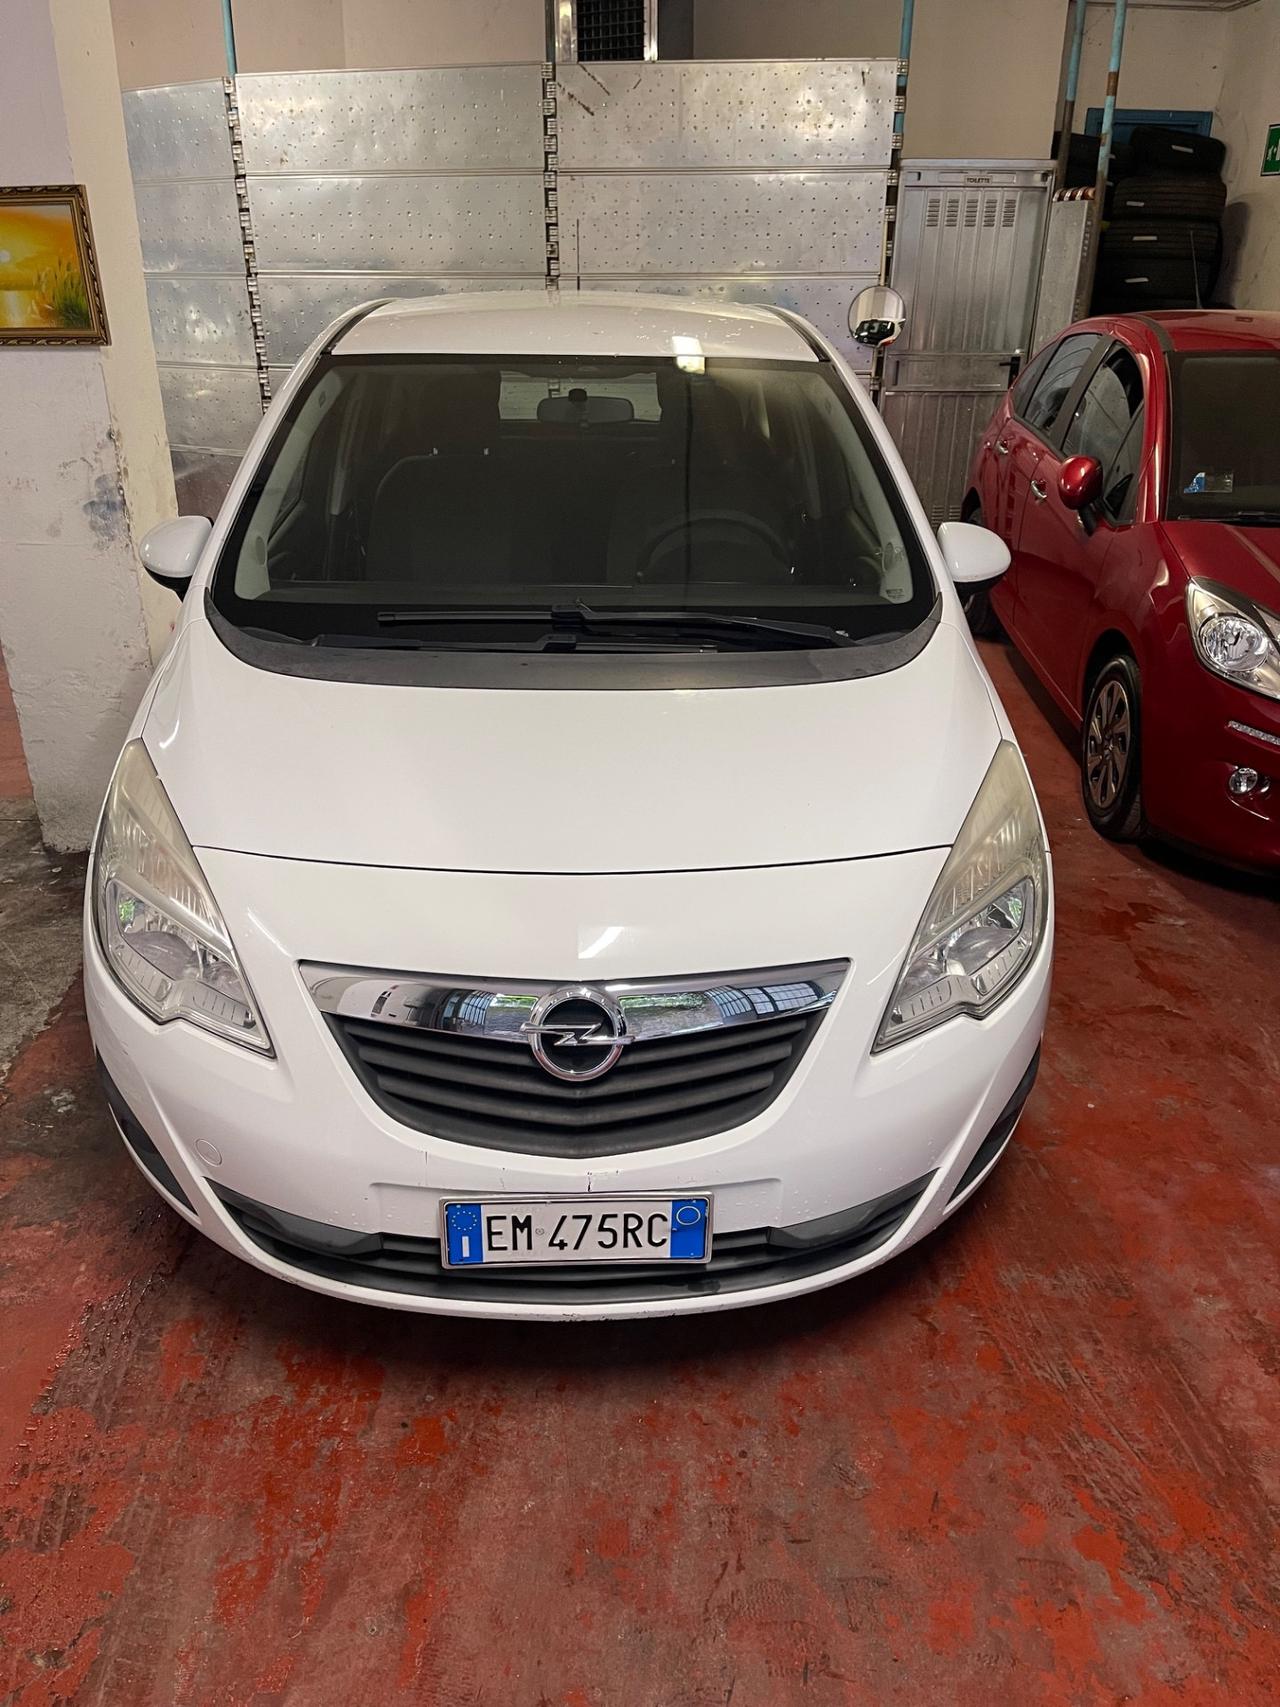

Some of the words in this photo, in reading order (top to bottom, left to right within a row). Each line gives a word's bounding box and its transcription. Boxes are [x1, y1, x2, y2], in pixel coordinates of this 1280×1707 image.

[461, 1235, 470, 1258] I
[486, 1214, 533, 1251] EM
[548, 1212, 668, 1250] 475RC
